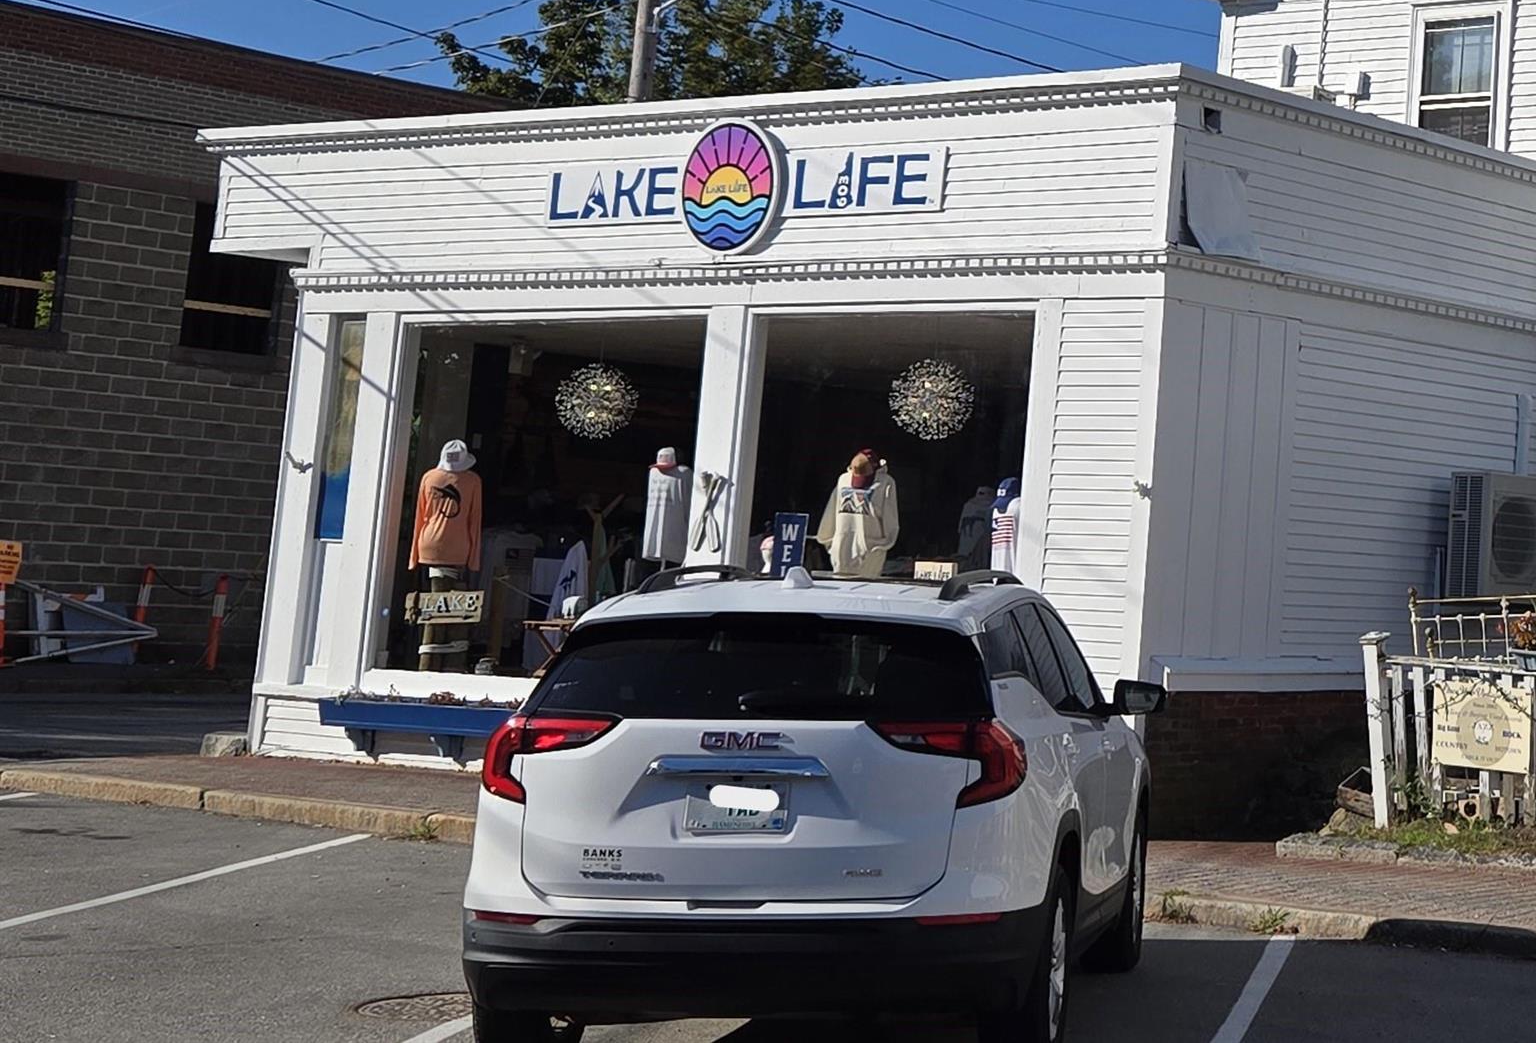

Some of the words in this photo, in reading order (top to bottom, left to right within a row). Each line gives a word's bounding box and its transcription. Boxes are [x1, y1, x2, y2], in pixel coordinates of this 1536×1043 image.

[549, 166, 679, 221] LAKE
[792, 151, 930, 209] LIFE
[706, 184, 726, 194] LAKE
[728, 179, 748, 193] LIFE
[836, 175, 849, 207] 603
[421, 594, 478, 613] LAKE
[700, 731, 783, 751] GMC
[1435, 741, 1468, 750] COUNTRY
[583, 848, 622, 858] BANKS
